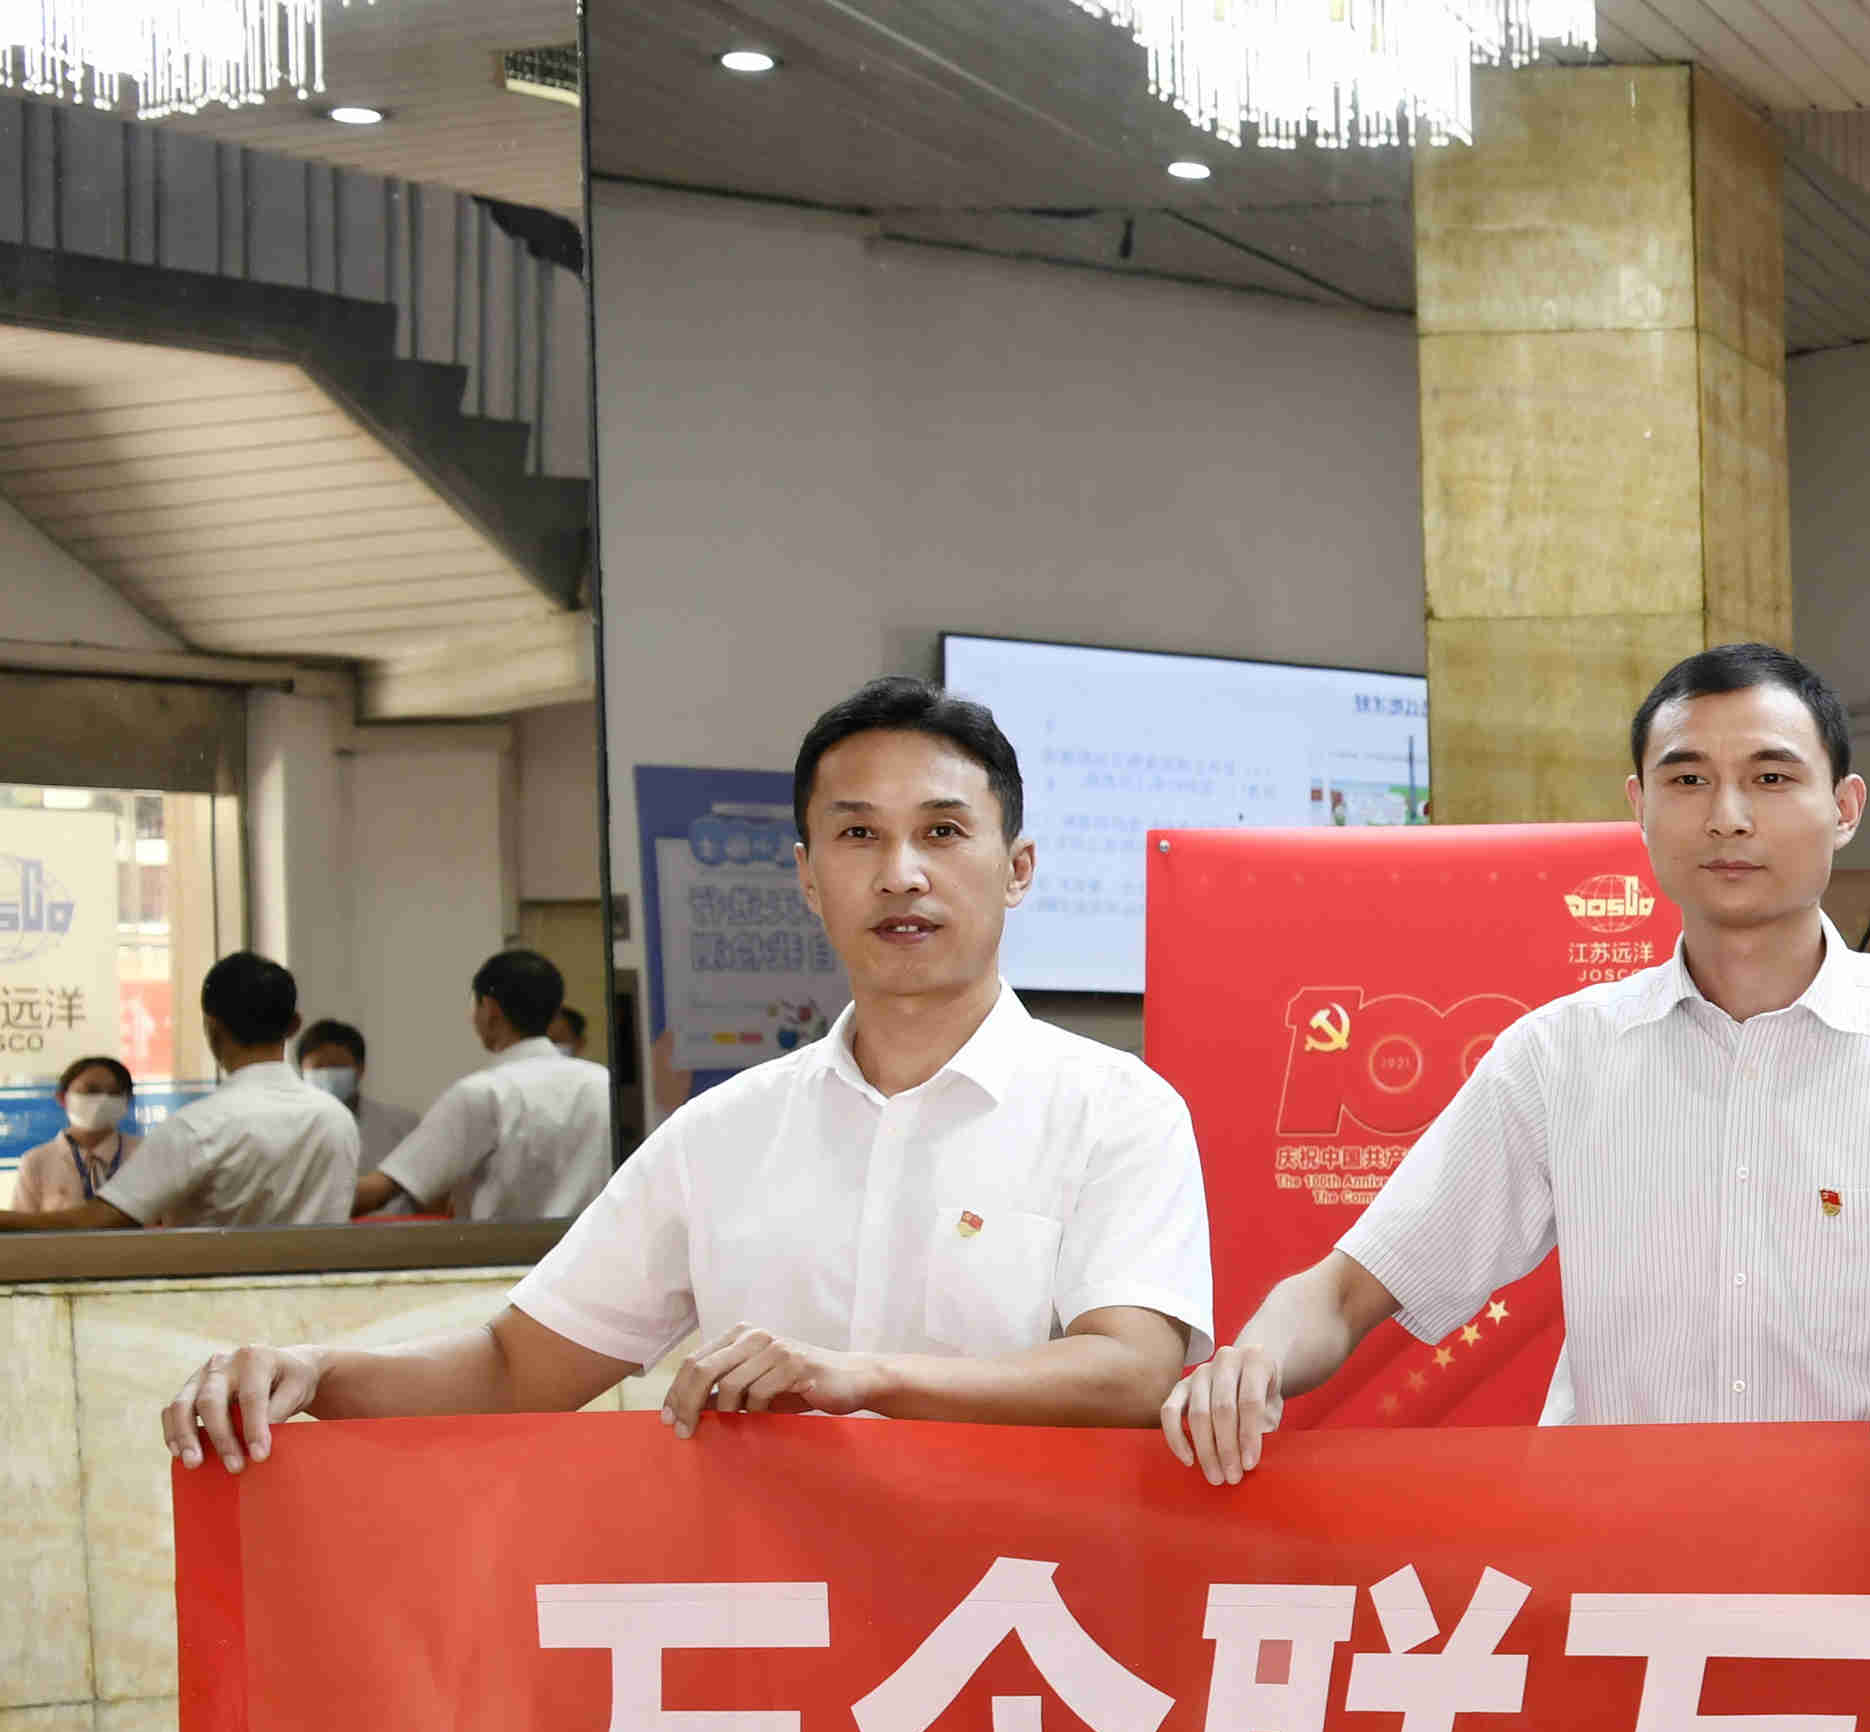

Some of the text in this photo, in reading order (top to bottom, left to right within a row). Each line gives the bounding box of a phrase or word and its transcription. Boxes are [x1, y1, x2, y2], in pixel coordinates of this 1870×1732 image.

[1568, 941, 1655, 964] 江苏远洋
[1, 985, 87, 1030] 远洋
[0, 1032, 44, 1051] CO
[1275, 1174, 1302, 1189] The
[1304, 1173, 1341, 1189] 100th
[1313, 1190, 1339, 1204] The
